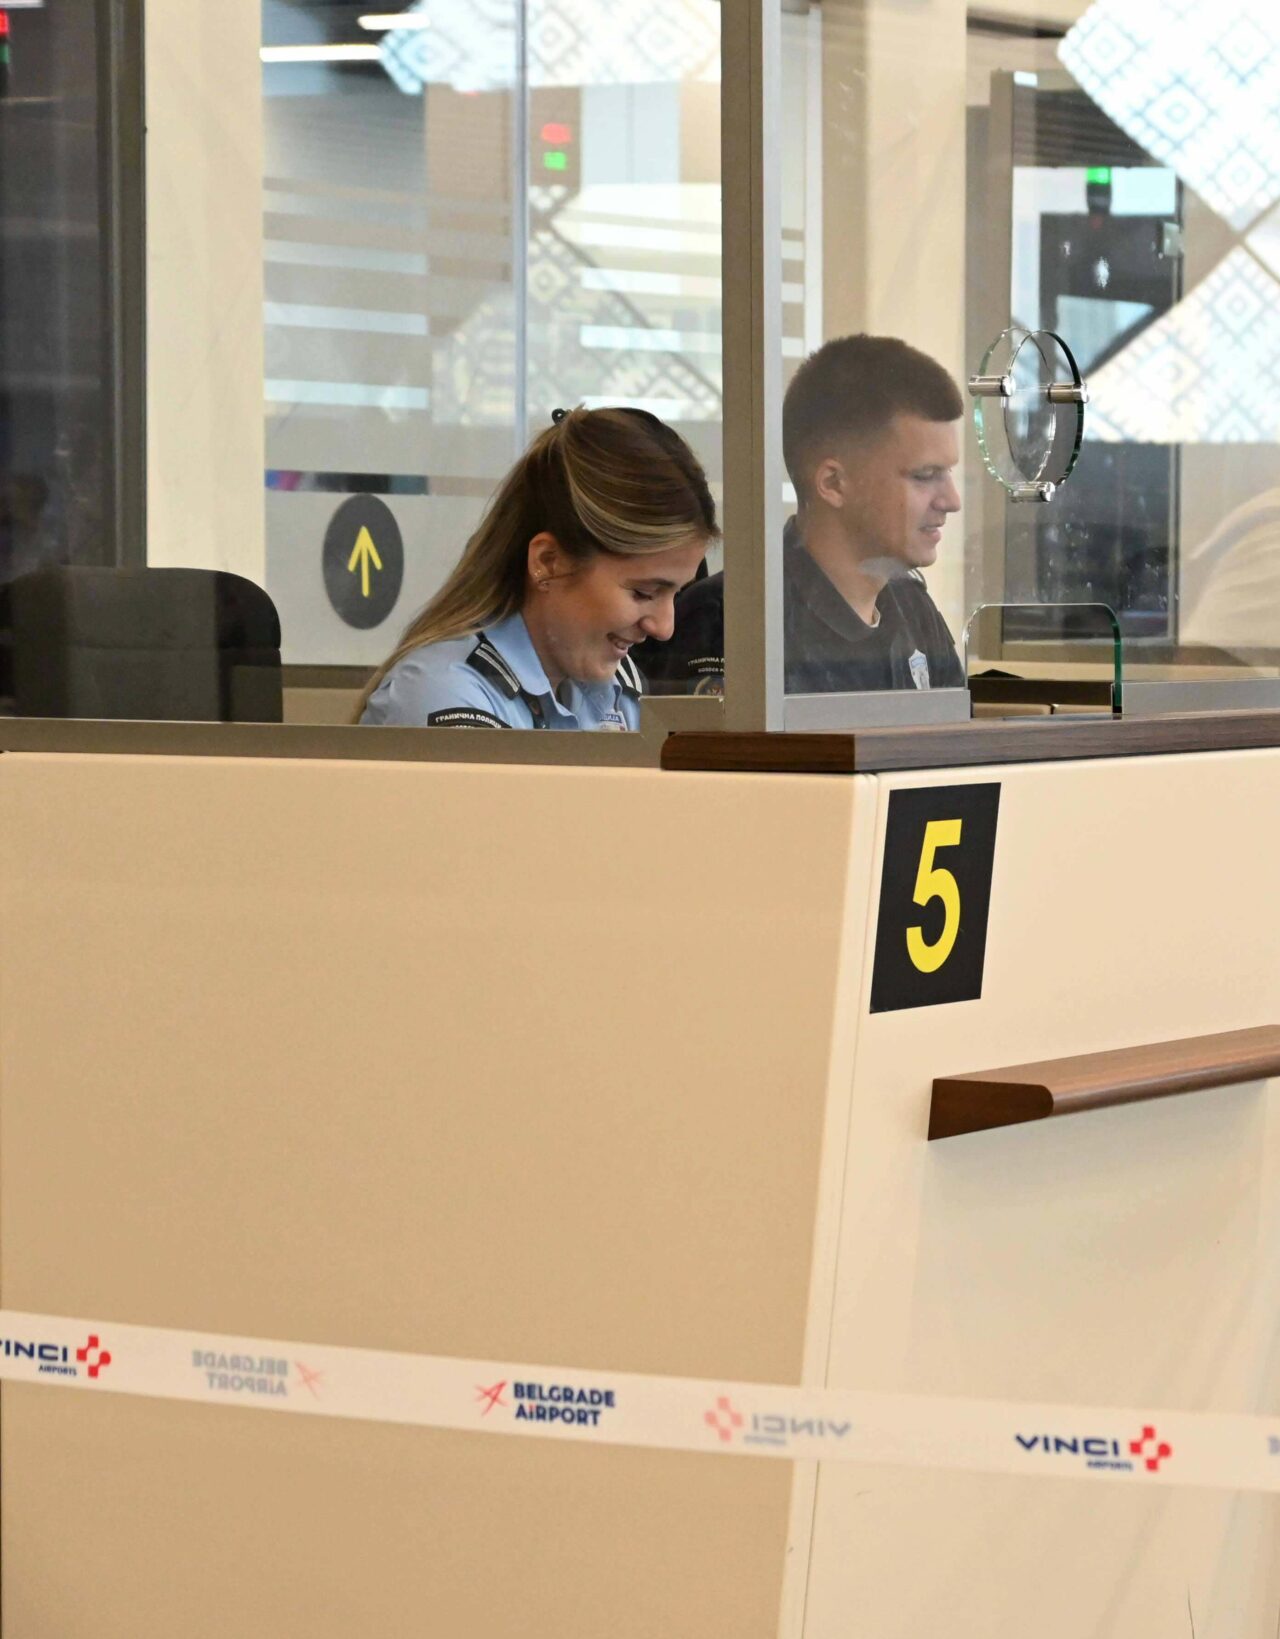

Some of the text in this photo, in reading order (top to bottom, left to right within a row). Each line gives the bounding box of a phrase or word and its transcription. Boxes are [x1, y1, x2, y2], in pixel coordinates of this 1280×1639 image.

[435, 713, 475, 723] ГРАНИЧНА
[906, 819, 963, 974] 5
[38, 1364, 77, 1376] AIRPORTS
[513, 1382, 616, 1409] BELGRADE
[1015, 1434, 1120, 1456] VINCI
